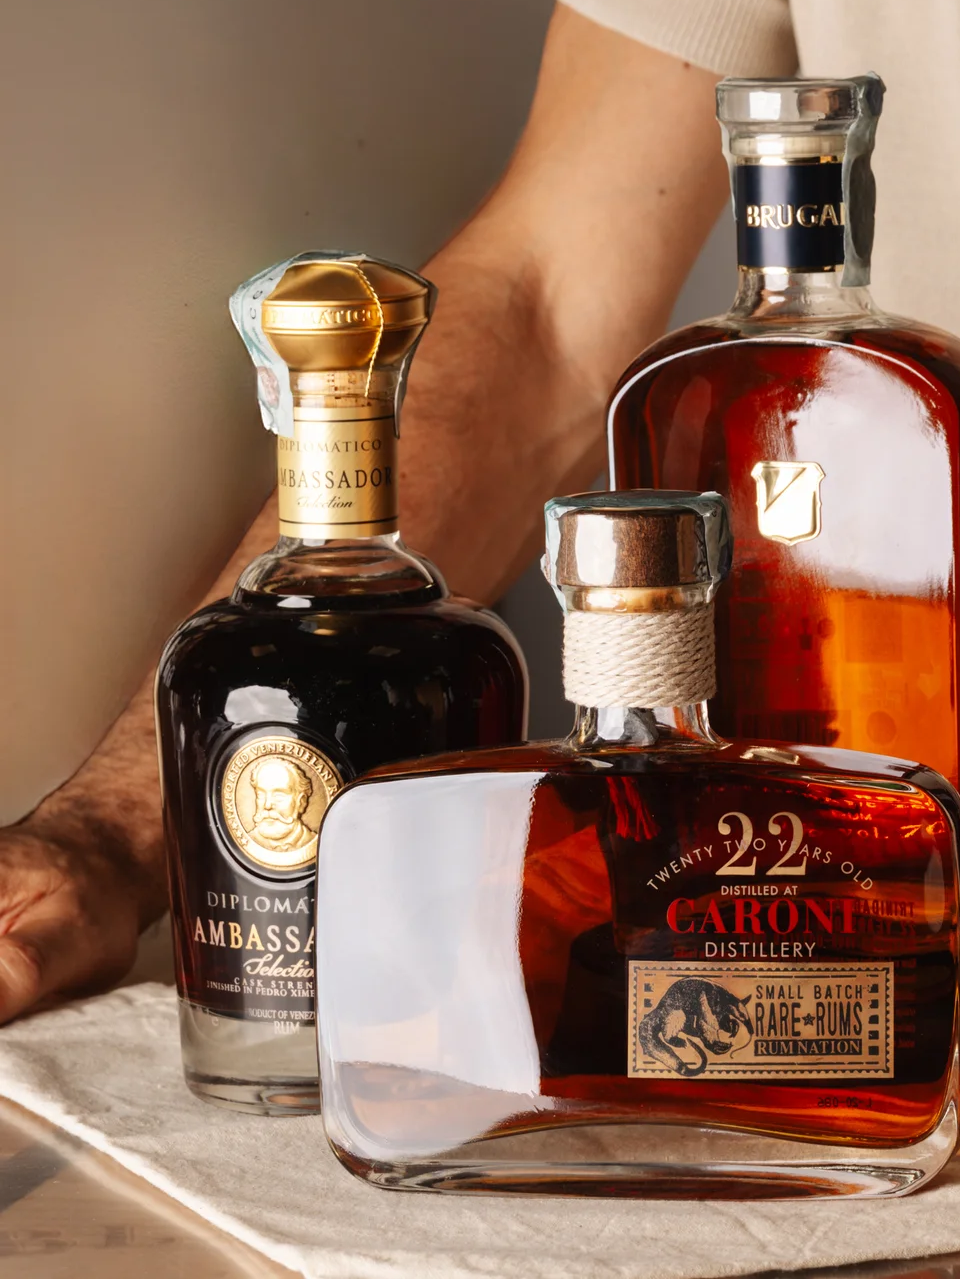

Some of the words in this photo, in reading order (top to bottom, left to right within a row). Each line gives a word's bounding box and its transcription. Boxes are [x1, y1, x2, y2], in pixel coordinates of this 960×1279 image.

[279, 466, 392, 489] MBASSADOR
[225, 752, 249, 821] IMPORTED
[251, 743, 333, 782] VENEZUELAN
[715, 811, 807, 876] 22
[646, 844, 713, 891] TWENTY
[723, 838, 766, 854] TWO
[840, 861, 874, 891] OLD
[720, 885, 779, 896] DISTILLED
[783, 885, 798, 895] AT
[206, 891, 315, 915] DIPLOMÁ
[666, 897, 857, 935] CARONI
[704, 941, 817, 958] DISTILLERY
[243, 953, 315, 978] Selectio
[233, 976, 264, 988] CASK
[271, 980, 313, 990] STREN
[243, 986, 253, 994] IN
[255, 988, 288, 997] PEDRO
[755, 985, 804, 1000] SMALL
[813, 984, 863, 1000] BATCH
[246, 1008, 276, 1019] RODUCT
[277, 1010, 288, 1019] OF
[290, 1010, 316, 1020] VENEZ
[755, 1002, 803, 1038] RARE
[815, 1002, 863, 1037] RUMS
[274, 1020, 301, 1035] RUM
[757, 1040, 795, 1055] RUM
[797, 1040, 861, 1055] NATION
